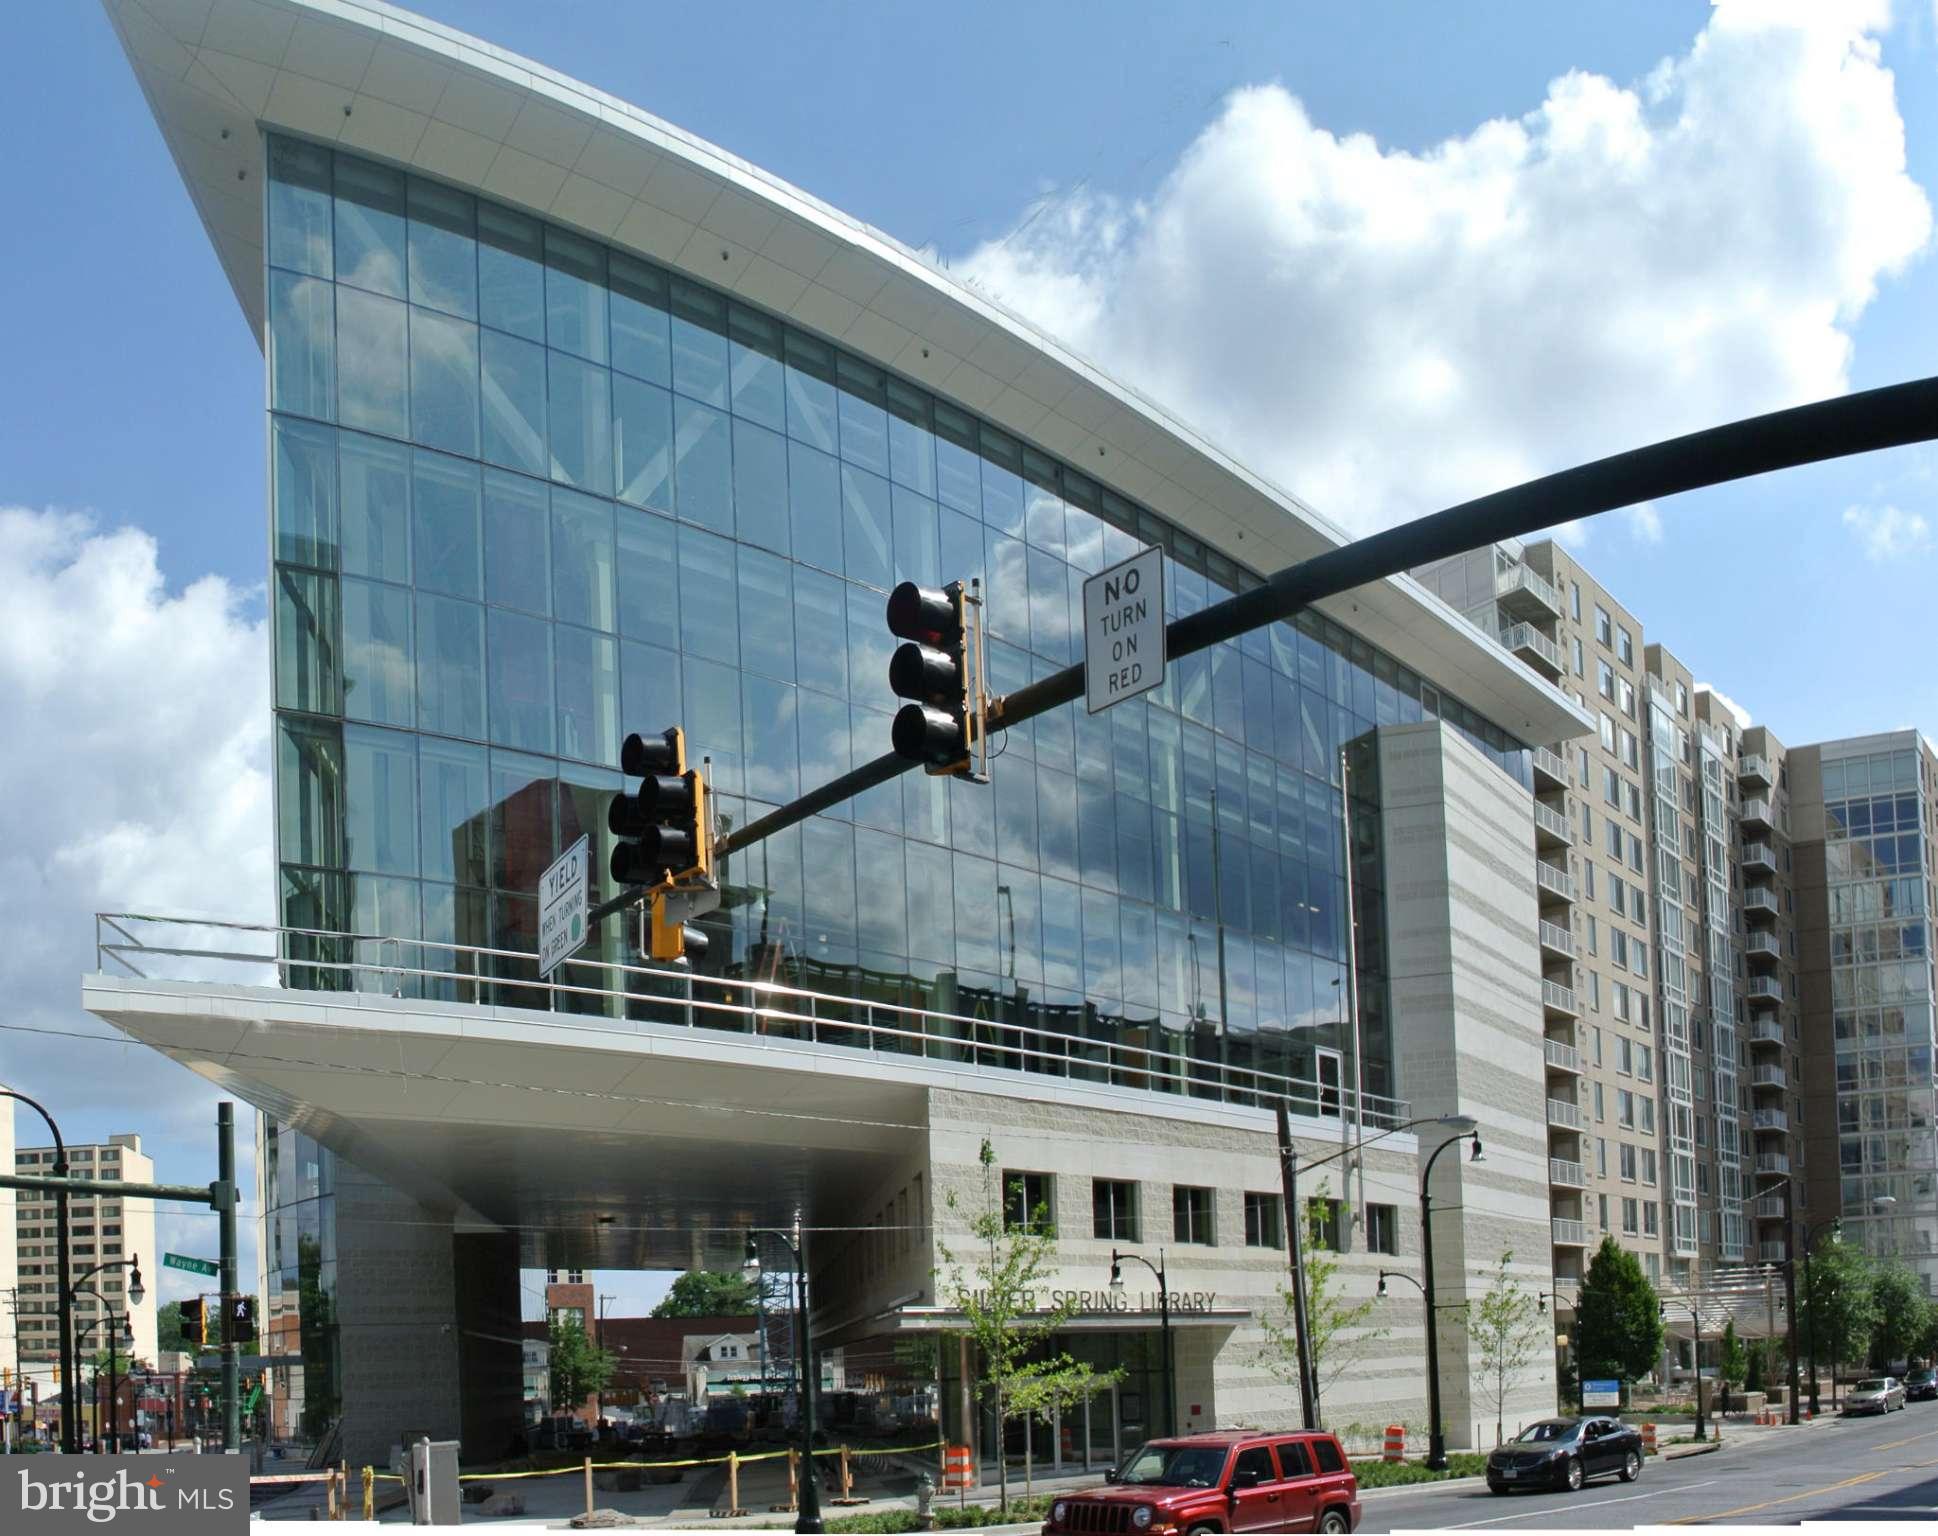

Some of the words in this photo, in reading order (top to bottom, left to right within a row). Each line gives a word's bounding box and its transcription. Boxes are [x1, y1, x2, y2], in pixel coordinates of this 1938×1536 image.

[1104, 568, 1140, 606] NO
[1100, 598, 1147, 637] TURN
[1112, 633, 1137, 661] ON
[1109, 663, 1142, 695] RED
[549, 855, 578, 898] YIELD
[542, 912, 557, 938] WHEN
[558, 889, 583, 922] TURNING
[551, 928, 568, 958] GREEN
[169, 1255, 198, 1272] Wayne
[957, 1288, 1035, 1313] SILER
[1050, 1289, 1128, 1313] SPRING
